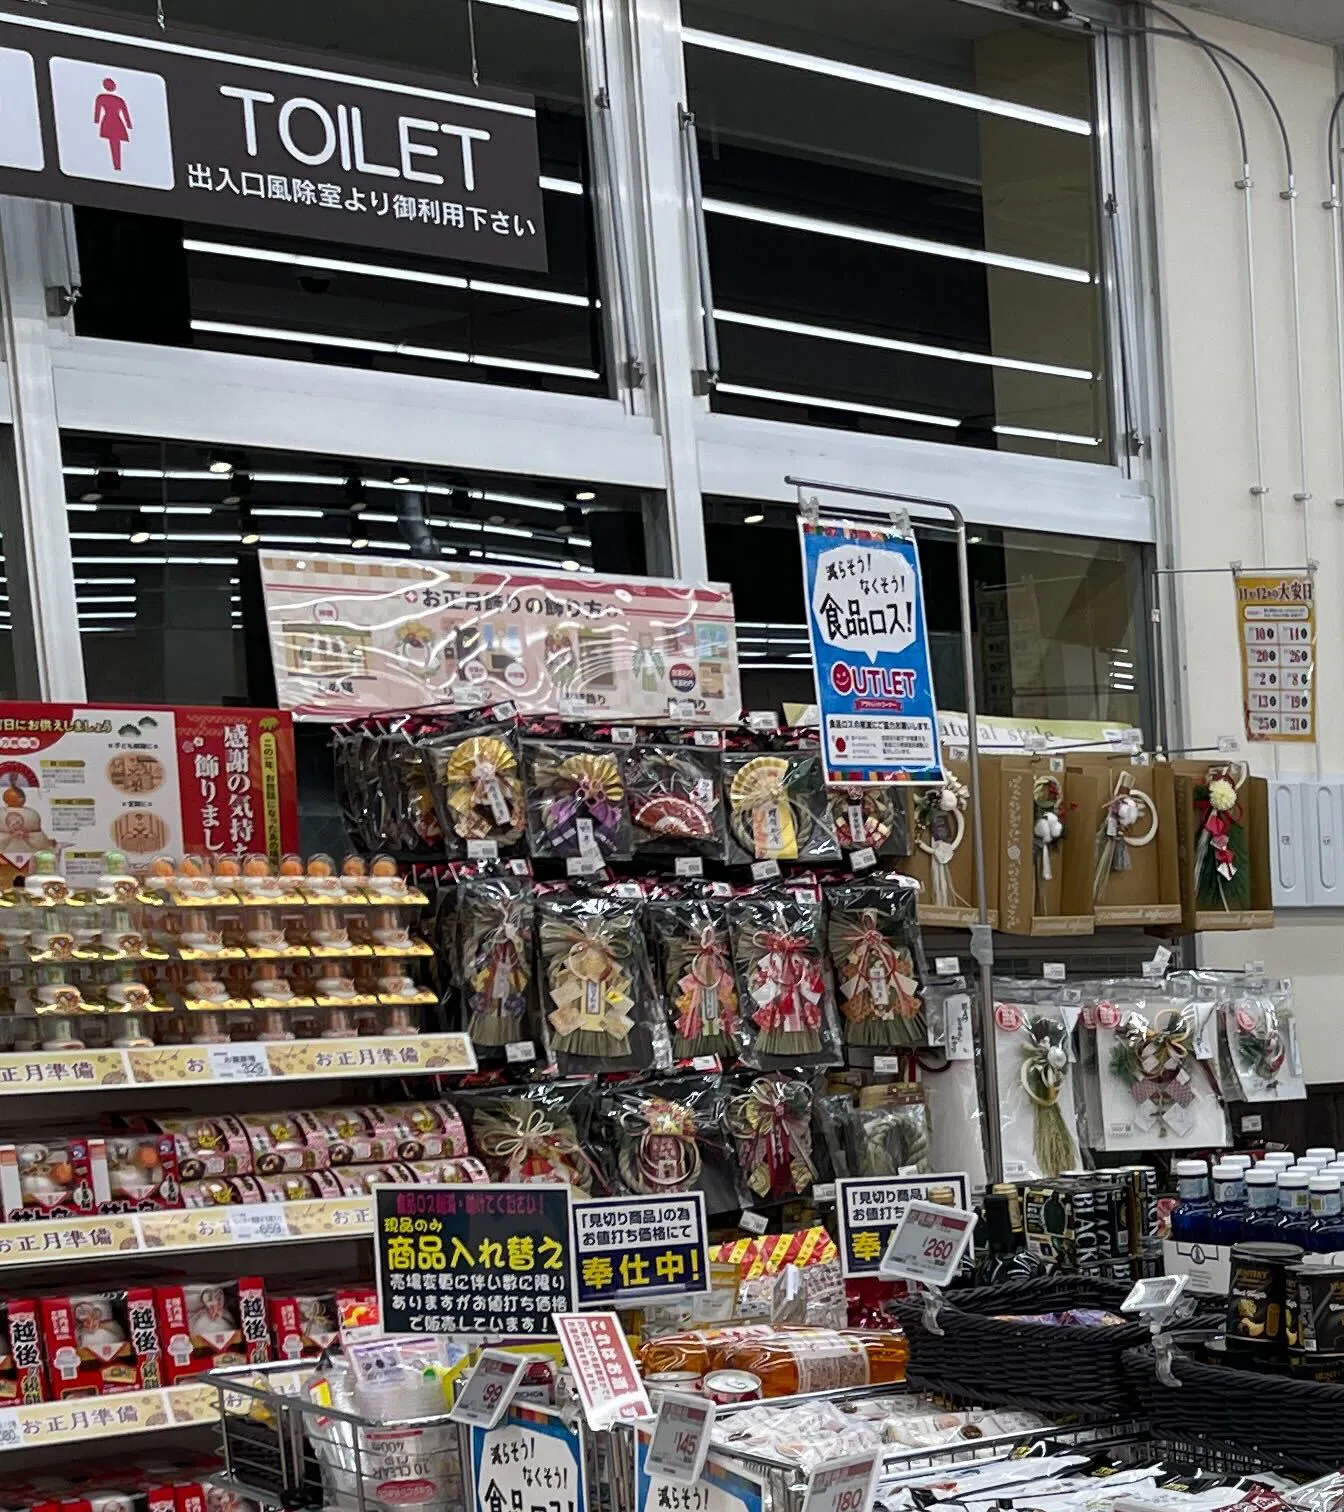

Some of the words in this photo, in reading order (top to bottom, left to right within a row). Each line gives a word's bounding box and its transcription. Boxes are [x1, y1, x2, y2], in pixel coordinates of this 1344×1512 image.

[220, 85, 491, 191] TOILET
[187, 163, 537, 239] 出入口風除室より御利用下さい
[825, 554, 872, 582] 減らそう!
[859, 575, 906, 596] なくそう!
[820, 594, 913, 640] 食品ロス!
[831, 661, 917, 697] OUTLET
[315, 1047, 420, 1068] お正月準備
[581, 1208, 691, 1230] 「見切り商品」の為
[582, 1225, 692, 1248] お値打ち価格にて
[924, 1236, 953, 1260] 260
[388, 1235, 564, 1271] 商品入れ替え
[389, 1273, 566, 1291] 売場変更に伴い数に限り
[581, 1250, 701, 1291] 奉仕中!
[391, 1294, 568, 1313] ありますがお値打ち価格
[408, 1315, 549, 1333] で販売しています!
[21, 1405, 139, 1435] お正月準備
[490, 1437, 535, 1465] 減らそう!
[522, 1467, 568, 1490] なくそう!
[657, 1487, 709, 1510] 減らそう!
